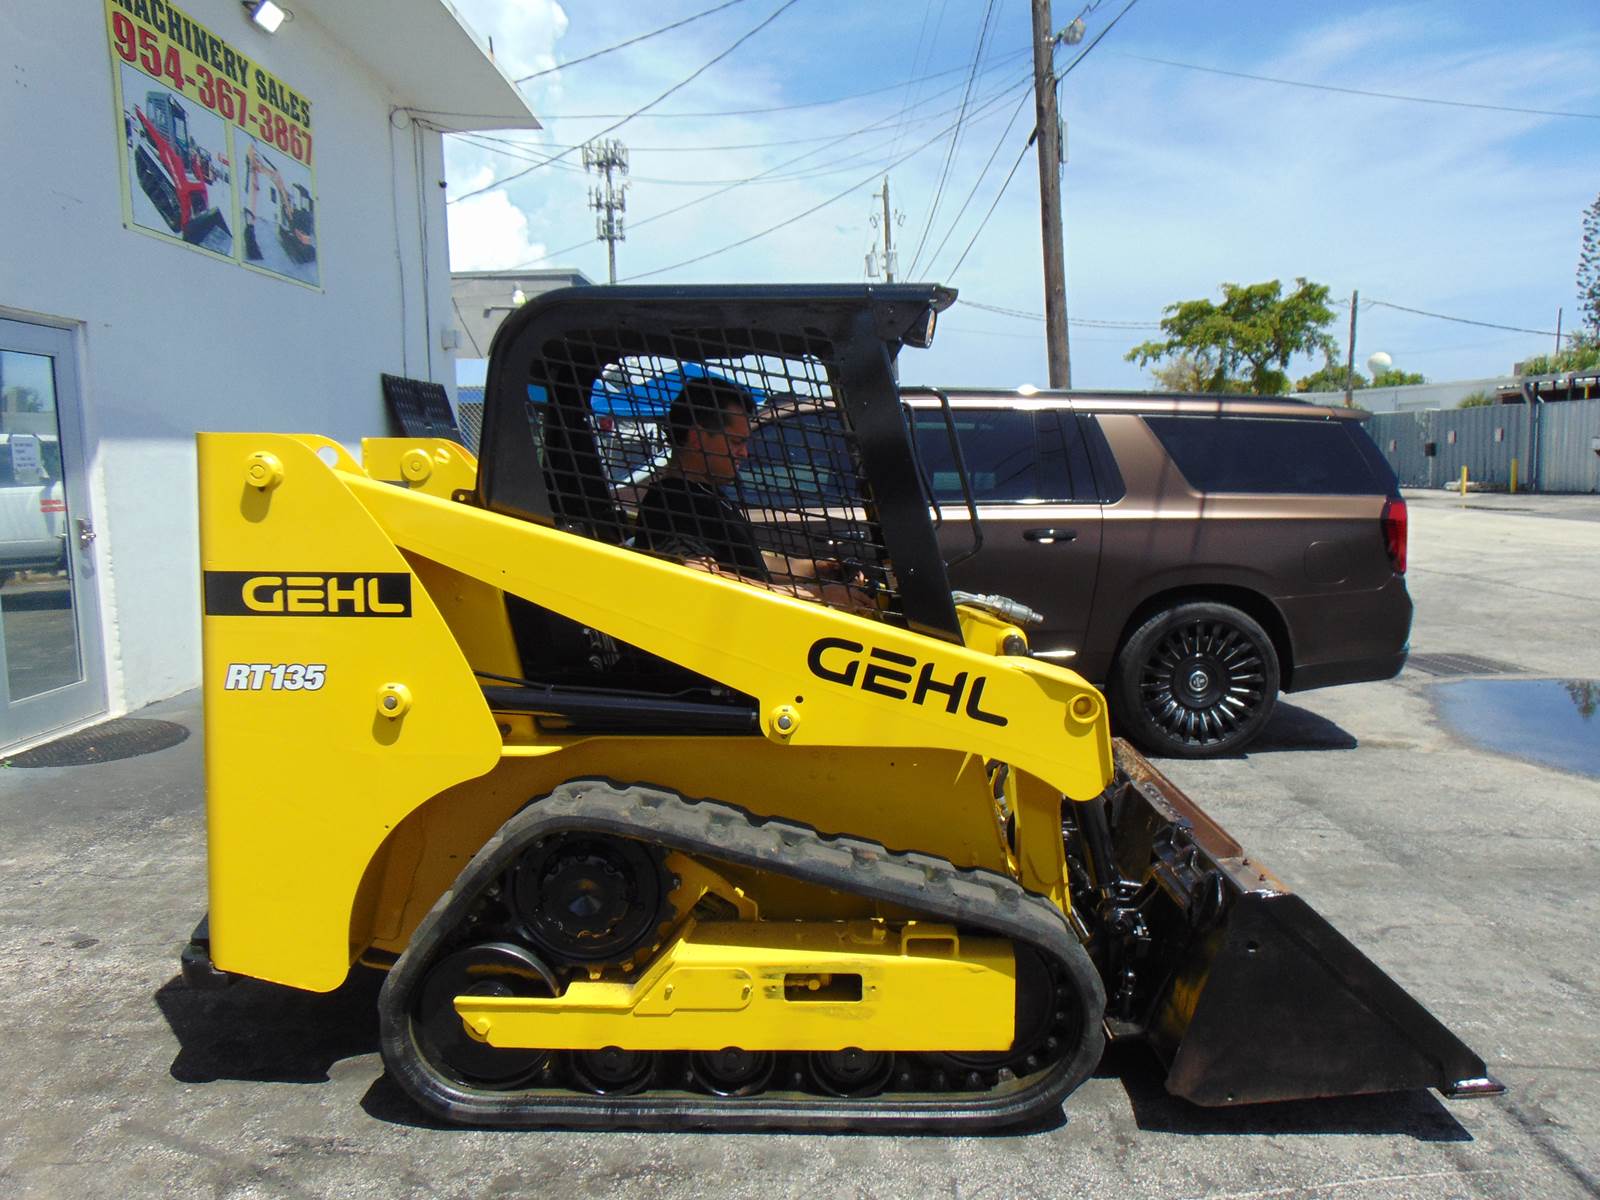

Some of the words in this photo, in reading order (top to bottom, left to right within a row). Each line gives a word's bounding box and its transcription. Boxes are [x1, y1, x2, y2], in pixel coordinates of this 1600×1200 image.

[111, 0, 249, 89] ACHINERY
[255, 70, 311, 129] SALES
[112, 11, 313, 166] 954-367-3867
[242, 576, 404, 613] GEHL
[225, 664, 327, 690] RT135
[807, 637, 1008, 727] GEHL
